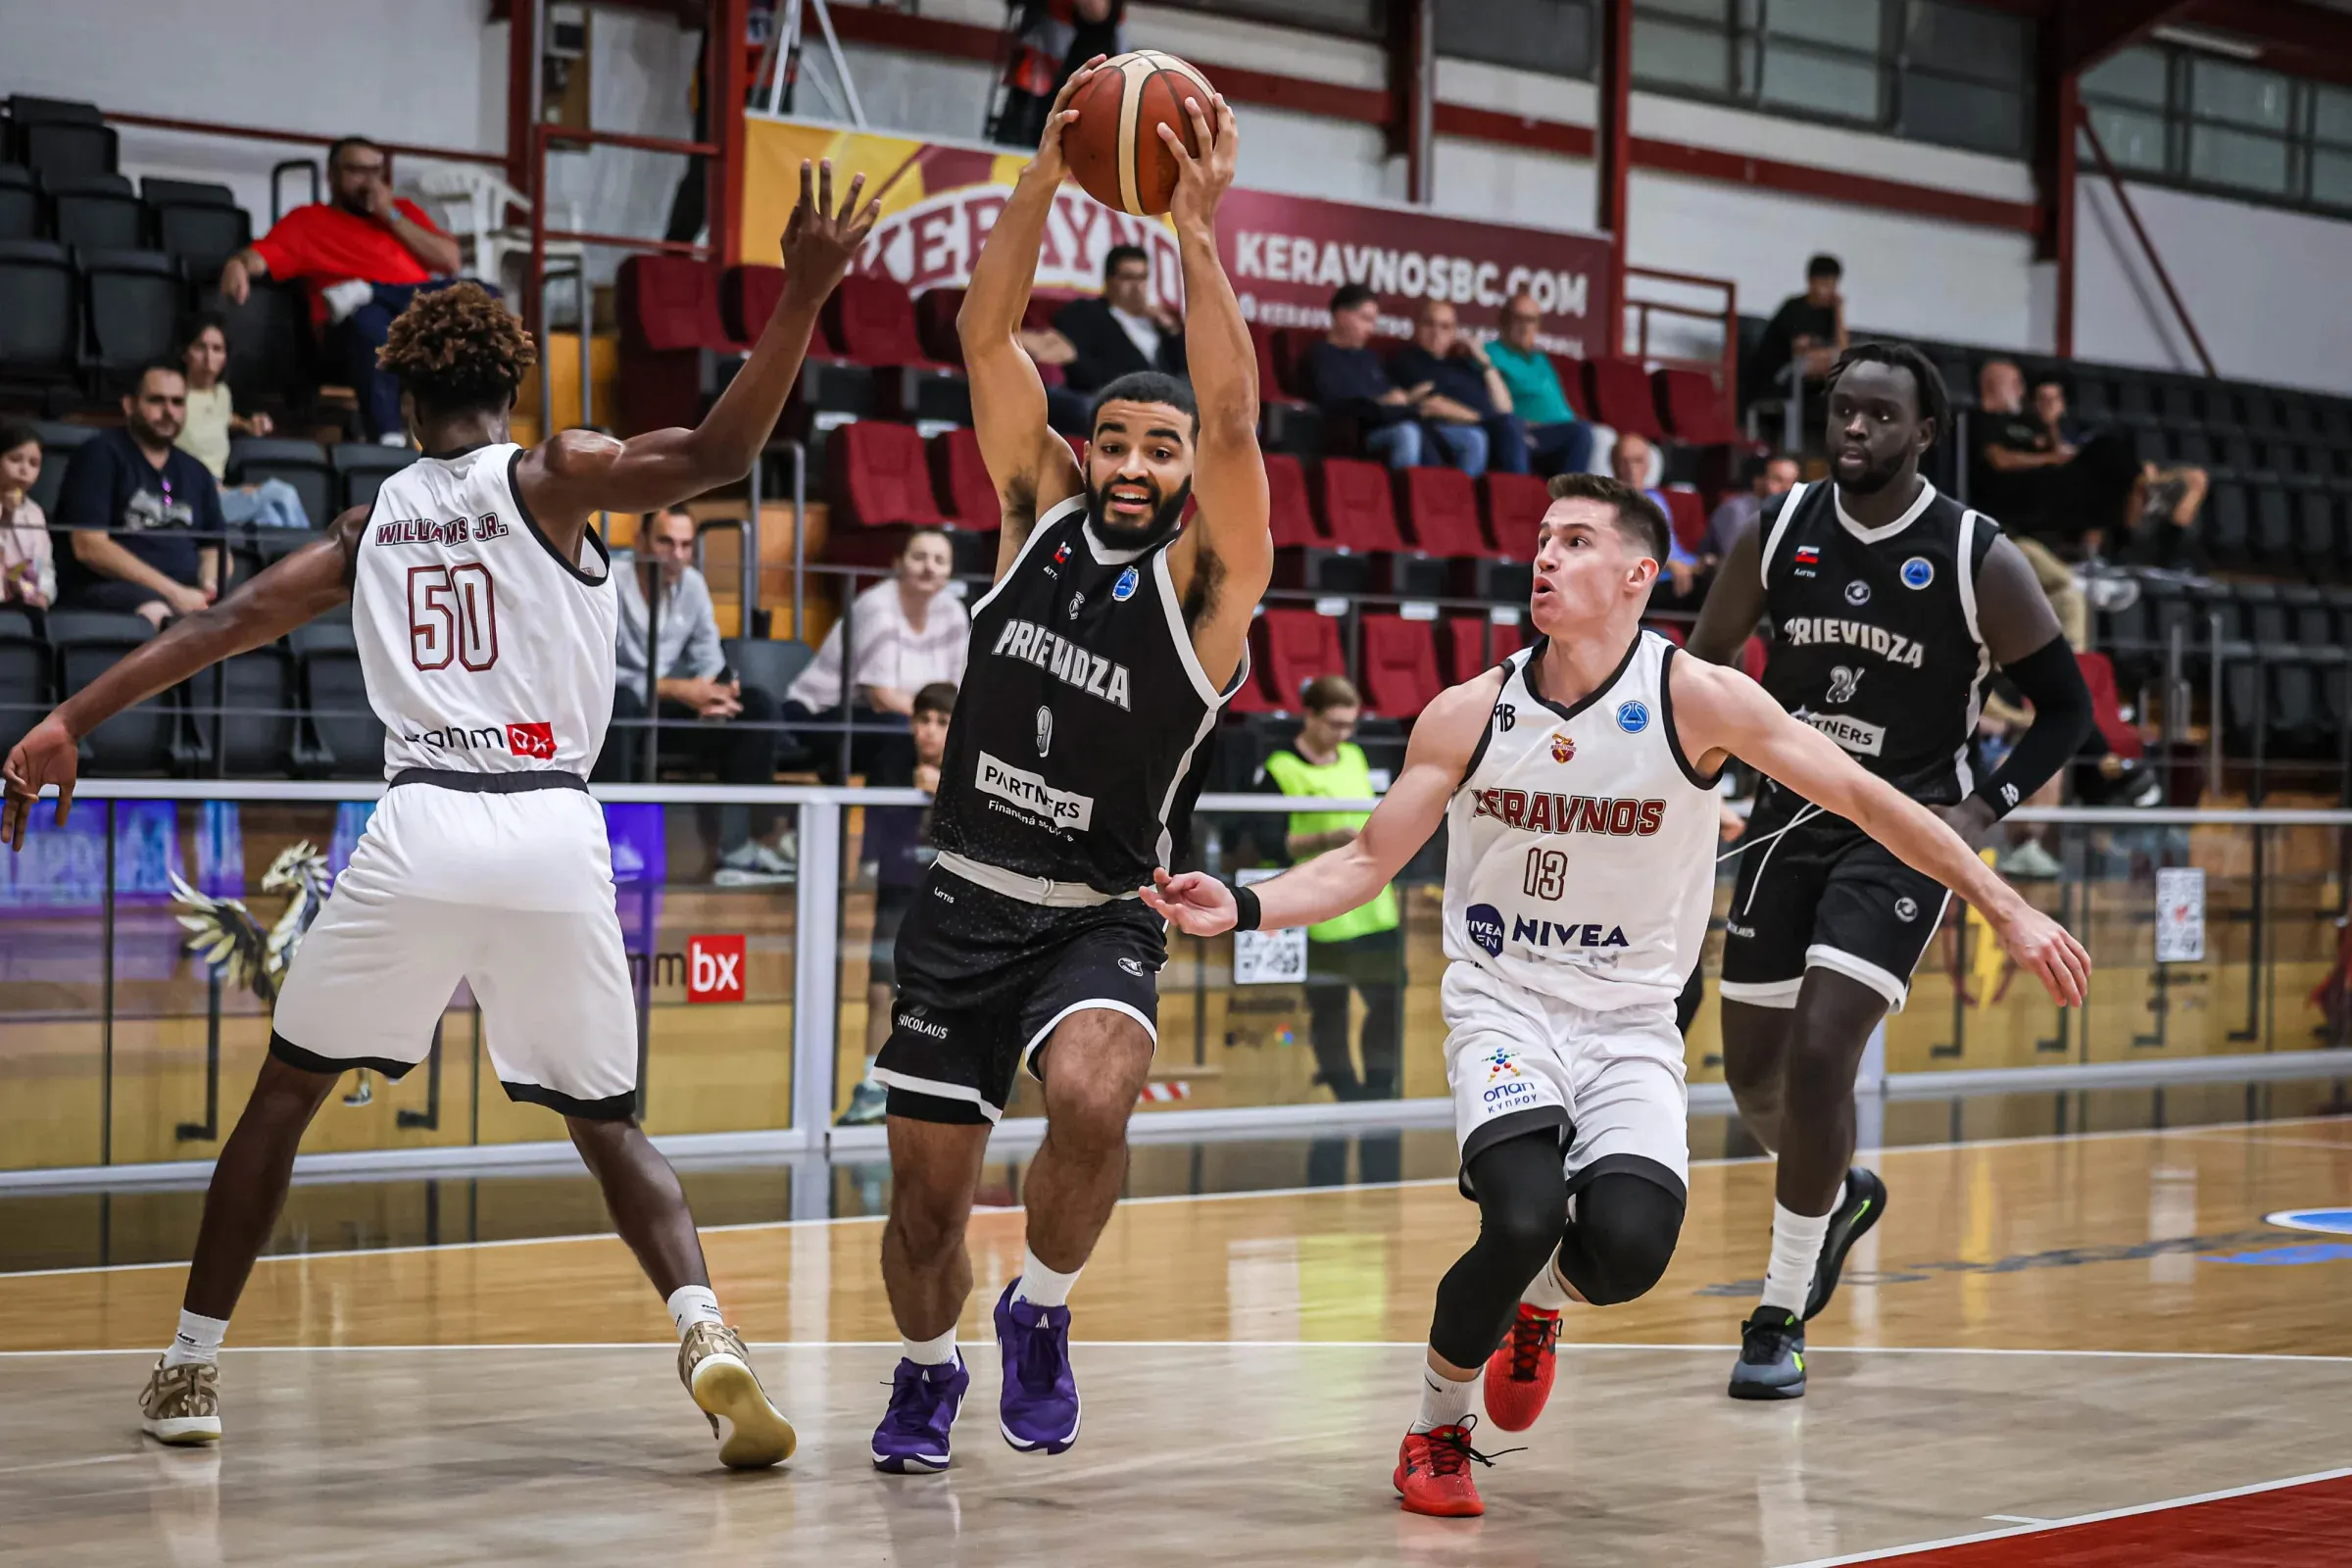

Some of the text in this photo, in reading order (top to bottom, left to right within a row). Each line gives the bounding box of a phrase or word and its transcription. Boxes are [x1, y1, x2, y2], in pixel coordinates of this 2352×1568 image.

[1235, 230, 1589, 319] KERAVNOSBC.COM
[375, 512, 509, 547] WILLIAMS JR.
[408, 563, 498, 672] 50
[1797, 715, 1873, 746] TNERS
[1523, 847, 1568, 902] 13
[1476, 934, 1497, 949] EN
[1511, 913, 1630, 948] NIVEA
[898, 1013, 949, 1040] NICOLAUS
